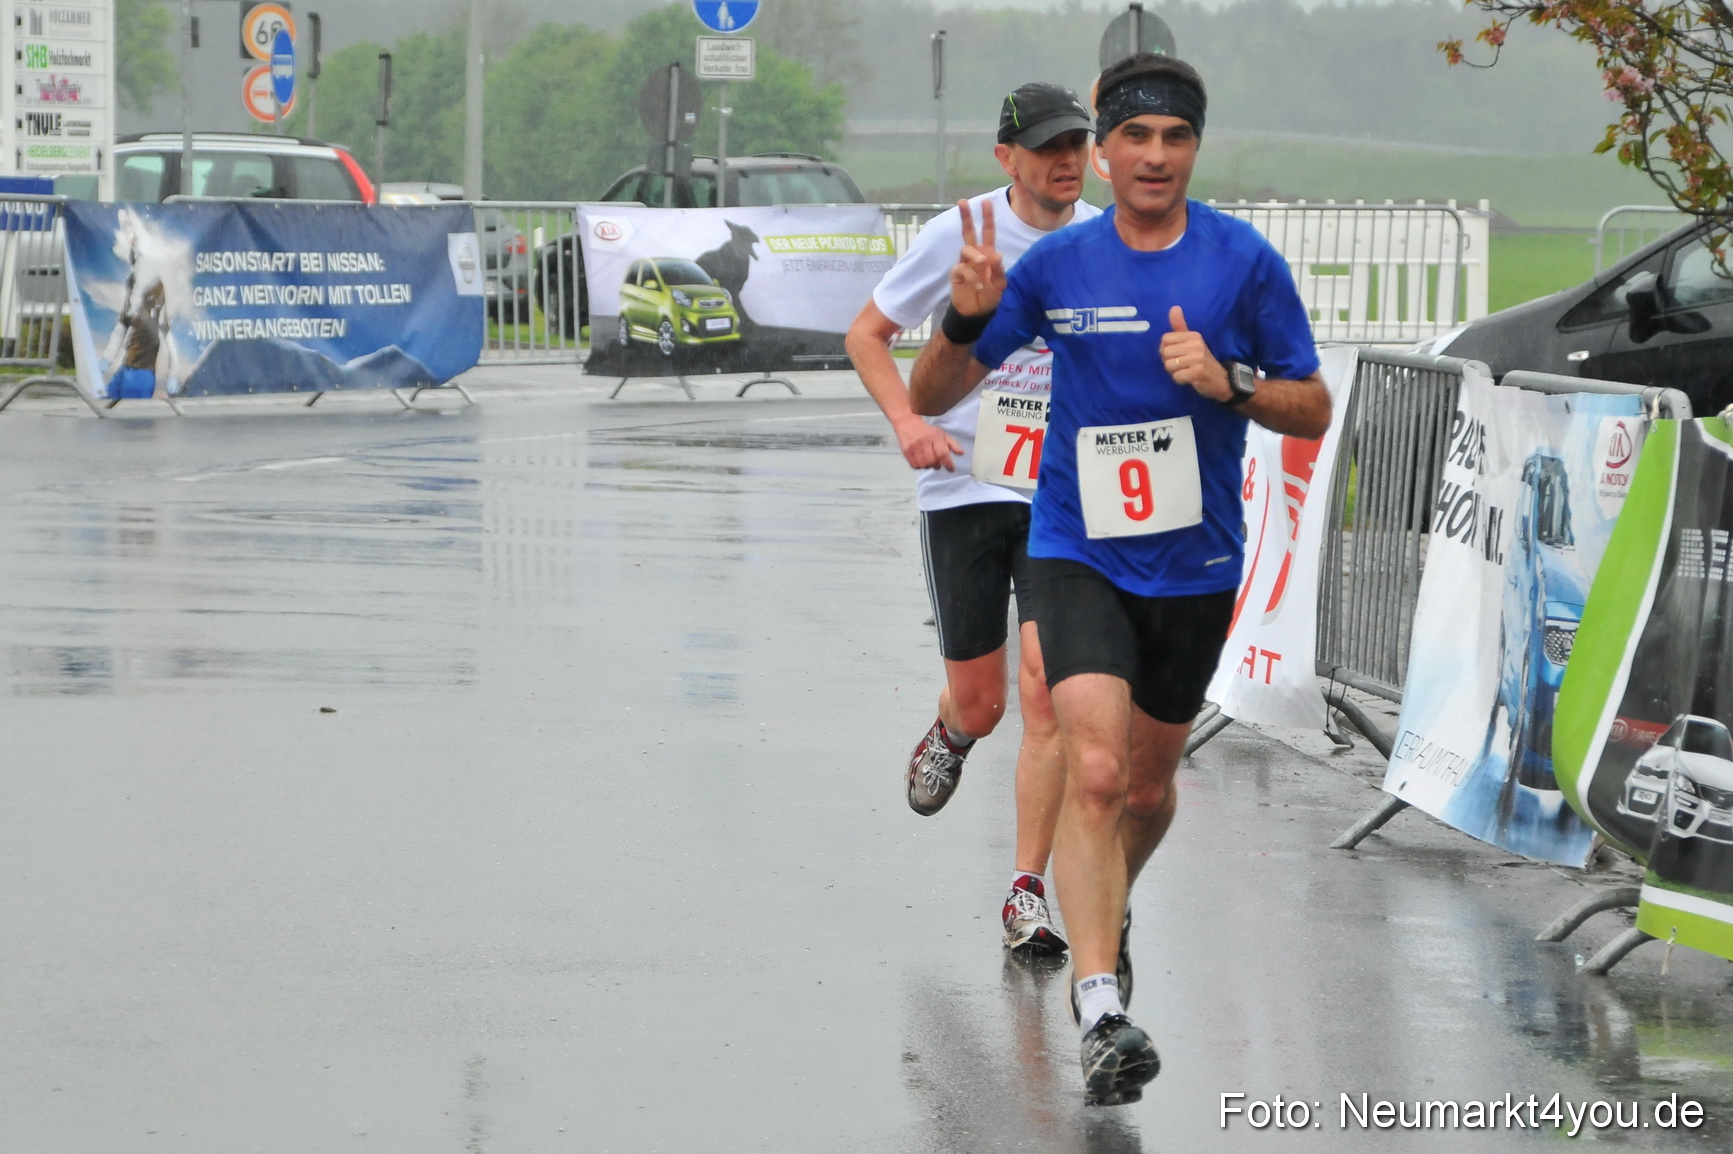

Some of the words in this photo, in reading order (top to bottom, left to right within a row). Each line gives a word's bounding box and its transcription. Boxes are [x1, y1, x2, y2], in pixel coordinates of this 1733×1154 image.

[26, 43, 48, 69] SHB
[25, 112, 61, 136] THULE
[769, 237, 792, 250] DER
[791, 237, 819, 250] NEUE
[818, 236, 857, 250] PICANTO
[195, 251, 296, 273] SAISONSTART
[300, 252, 324, 273] BEI
[327, 252, 386, 272] NISSAN:
[192, 285, 238, 307] GANZ
[240, 285, 275, 305] WEIT
[276, 285, 324, 305] VORN
[328, 285, 353, 304] MIT
[355, 284, 411, 304] TOLLEN
[193, 317, 347, 340] WINTERANGEBOTEN
[1029, 365, 1052, 376] MIT
[1000, 378, 1021, 388] Heck
[1030, 382, 1042, 391] Dr.
[997, 407, 1043, 420] WERBUNG
[998, 397, 1043, 412] MEYER
[1096, 430, 1148, 446] MEYER
[1003, 424, 1045, 480] 71
[1096, 443, 1150, 455] WERBUNG
[1119, 458, 1155, 522] 9
